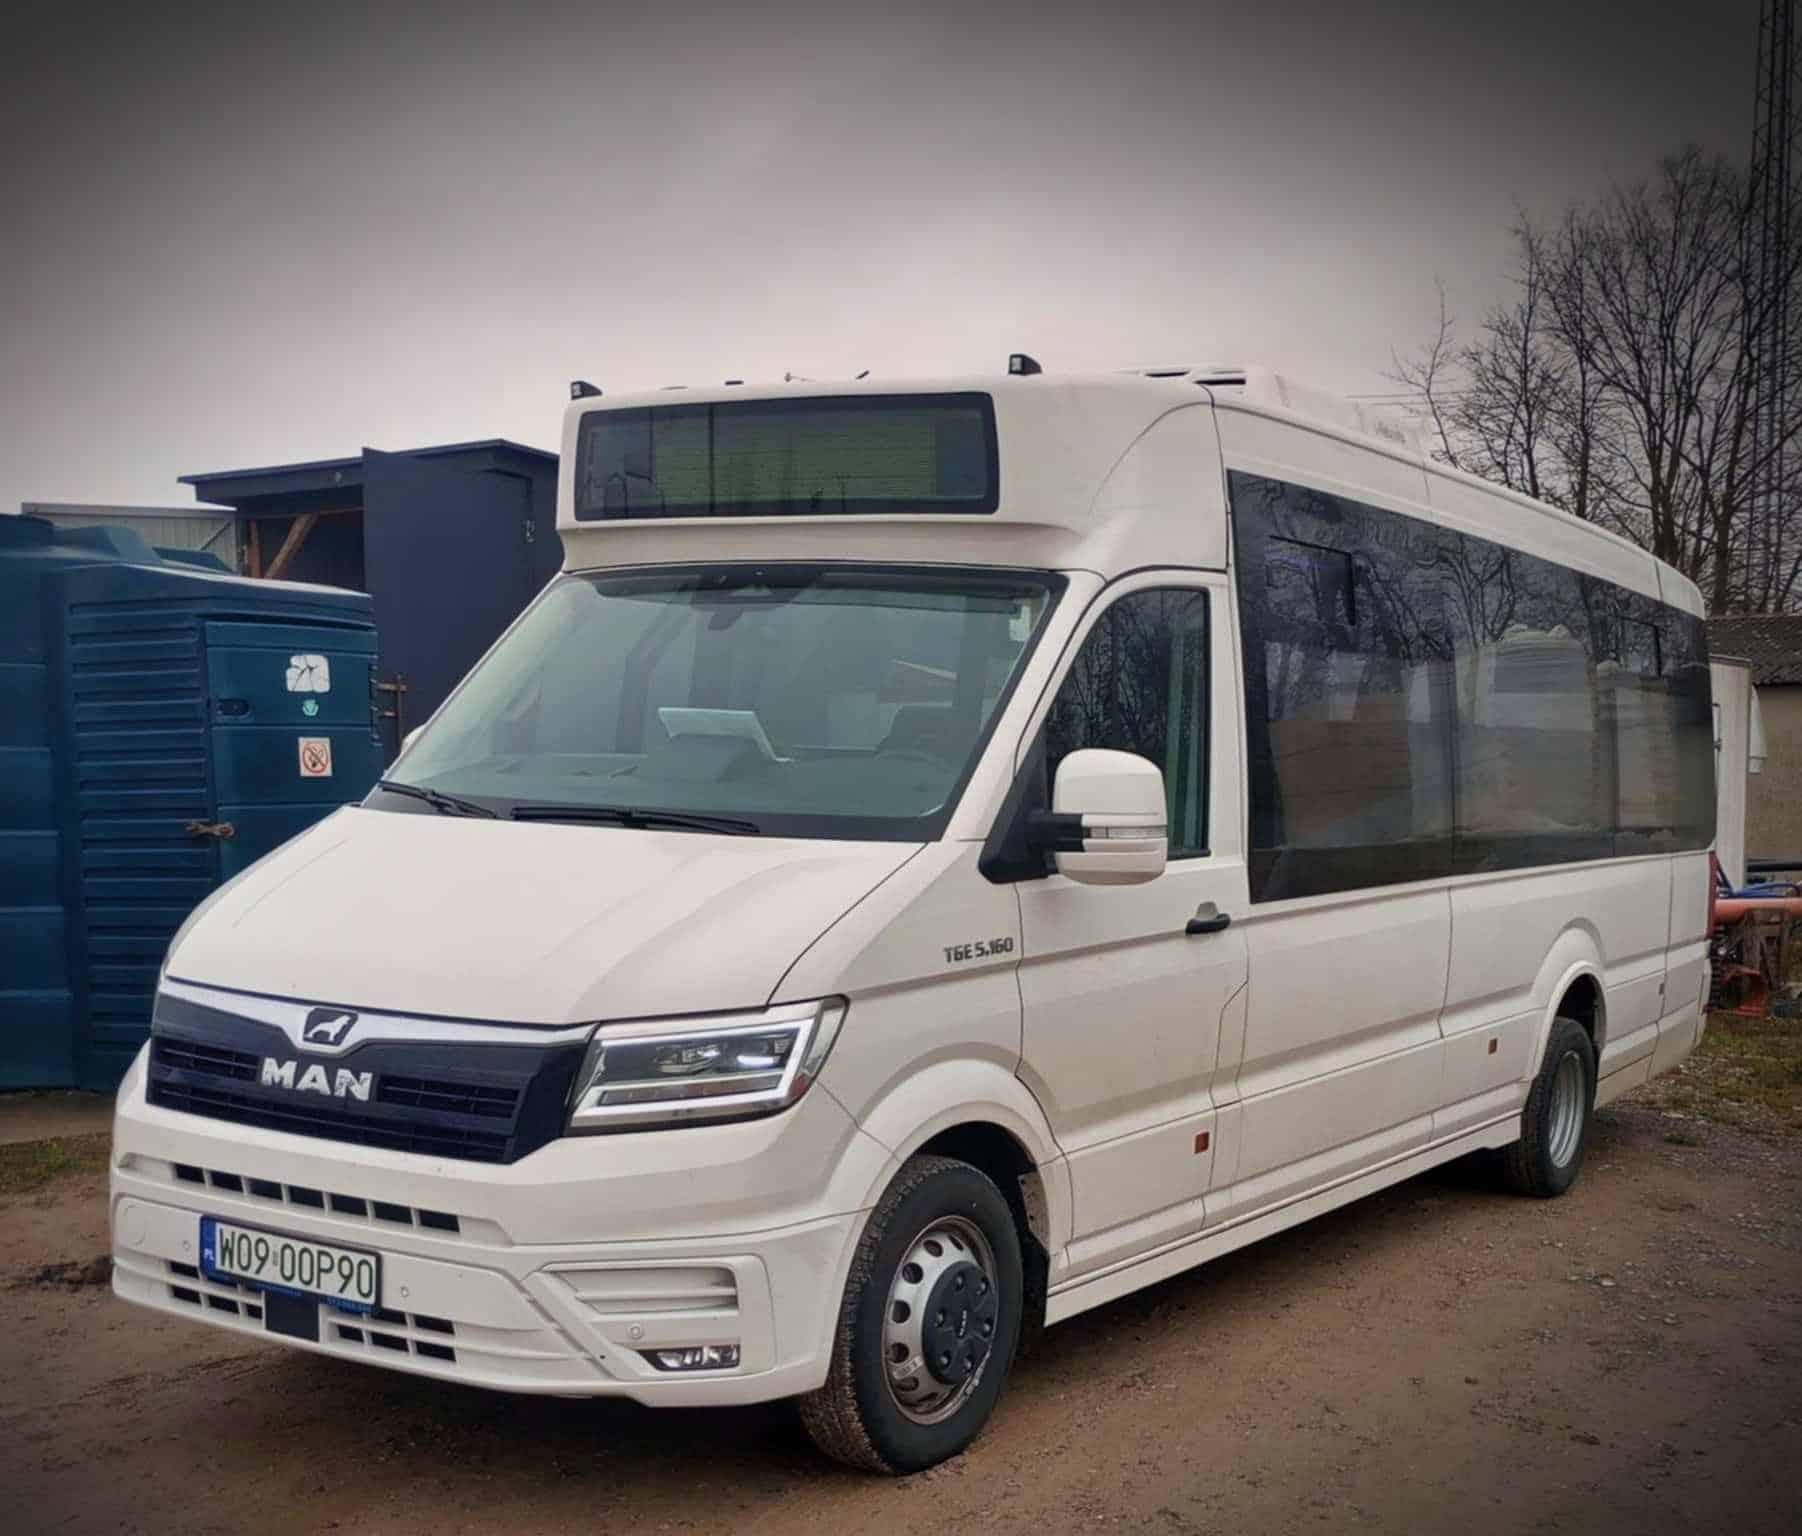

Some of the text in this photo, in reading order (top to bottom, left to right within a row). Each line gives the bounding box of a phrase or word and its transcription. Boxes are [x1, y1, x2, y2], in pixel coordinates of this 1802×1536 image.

[944, 937, 1014, 963] TGE 5.160
[261, 1057, 373, 1101] MAN
